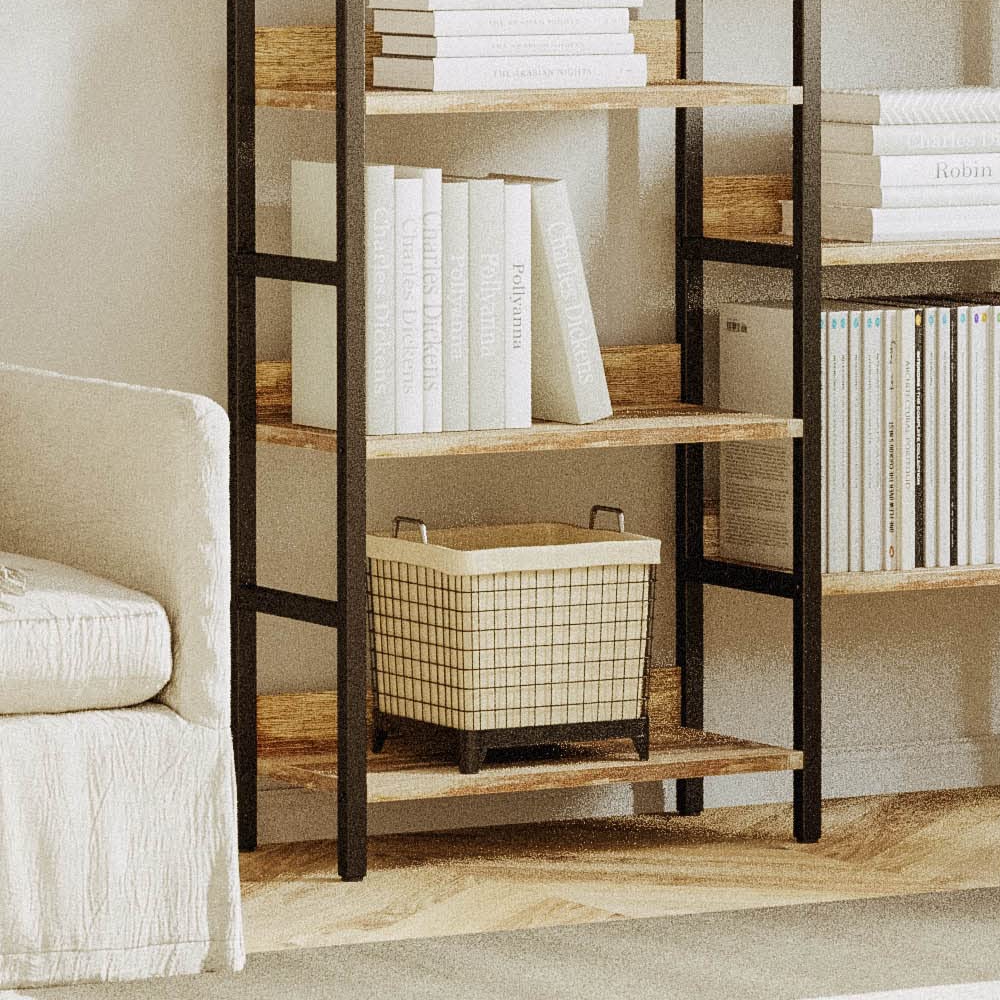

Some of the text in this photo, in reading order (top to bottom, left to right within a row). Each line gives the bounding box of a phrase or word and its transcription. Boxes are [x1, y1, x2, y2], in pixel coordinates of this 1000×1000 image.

[908, 131, 975, 149] Charles
[936, 162, 992, 179] Robin
[373, 206, 391, 395] Charles Dickens
[402, 217, 419, 395] Charles Dickens
[423, 211, 442, 393] Charles Dickens
[475, 251, 501, 359] Pollyanna
[509, 263, 526, 350] Pollyanna
[551, 221, 594, 385] Charles Dickens
